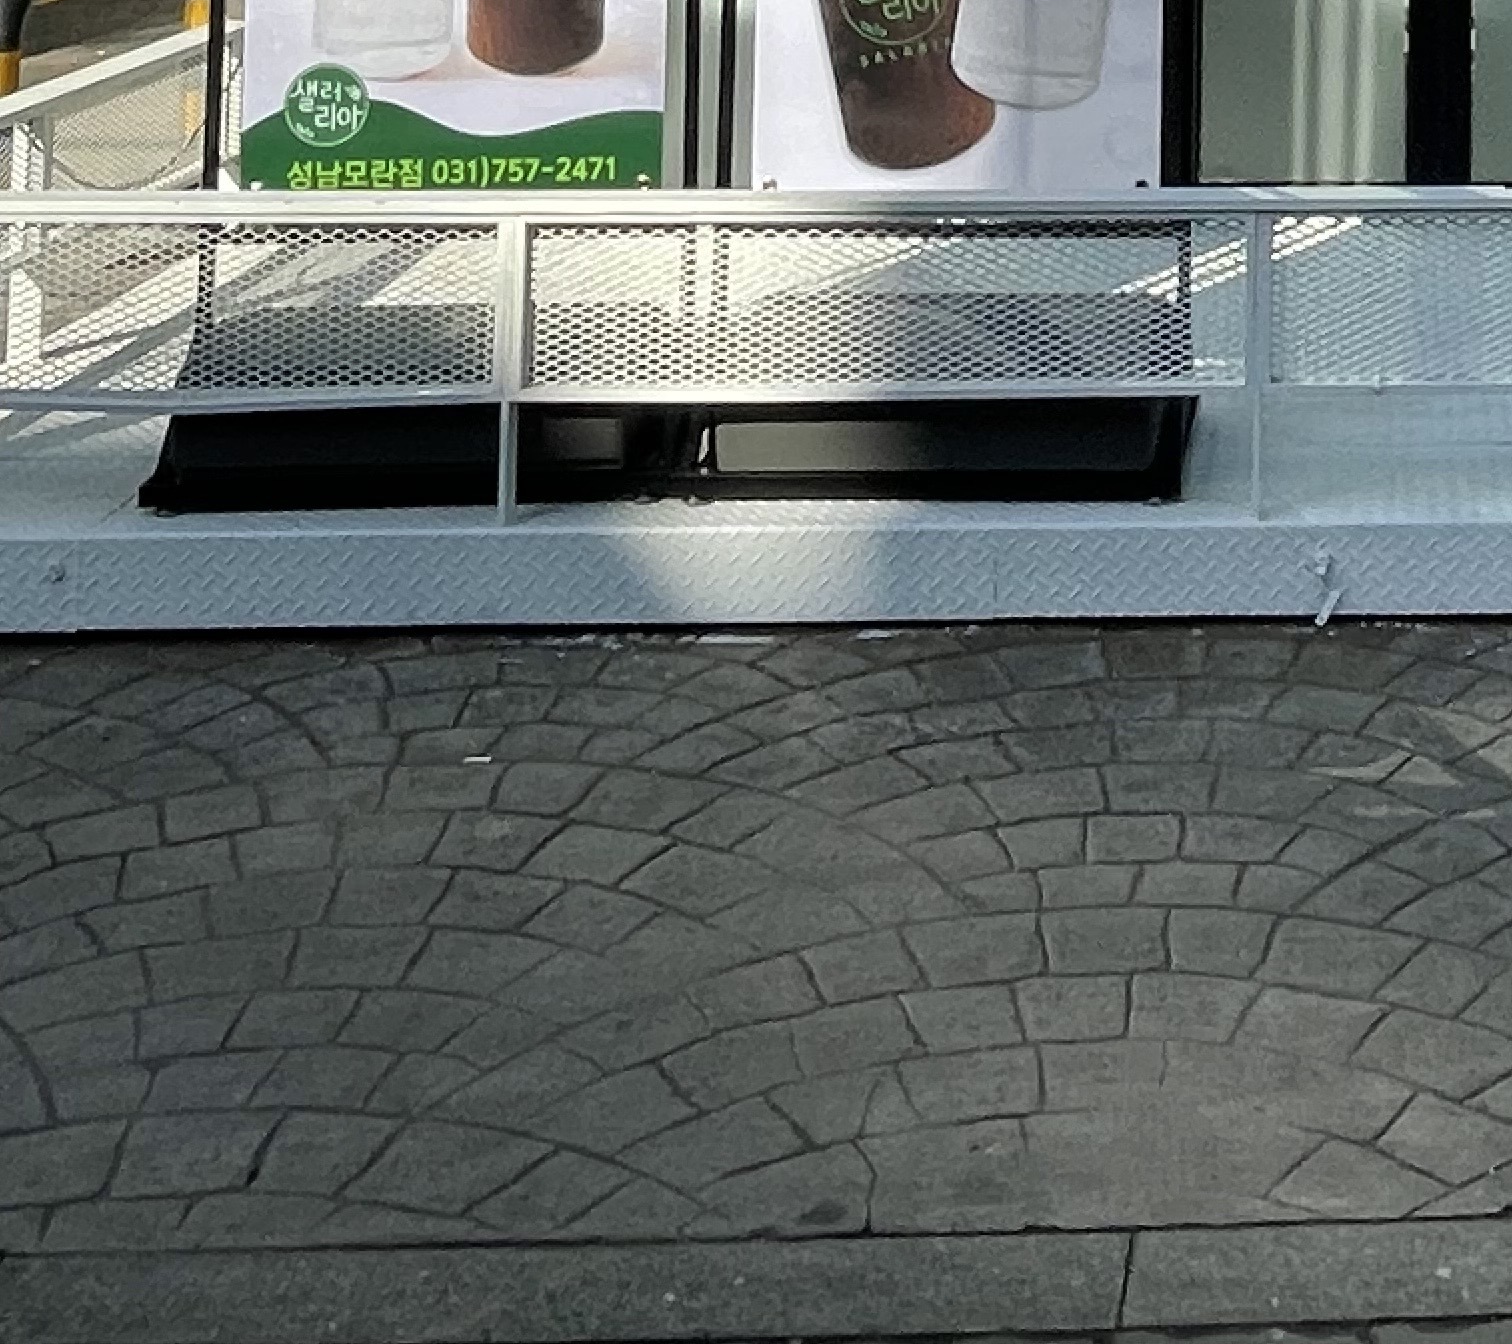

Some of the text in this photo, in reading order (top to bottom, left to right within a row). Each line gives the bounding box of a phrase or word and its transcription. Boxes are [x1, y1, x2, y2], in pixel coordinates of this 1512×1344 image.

[314, 102, 364, 132] 리아
[286, 156, 617, 190] 성남모란점 031)757-2471
